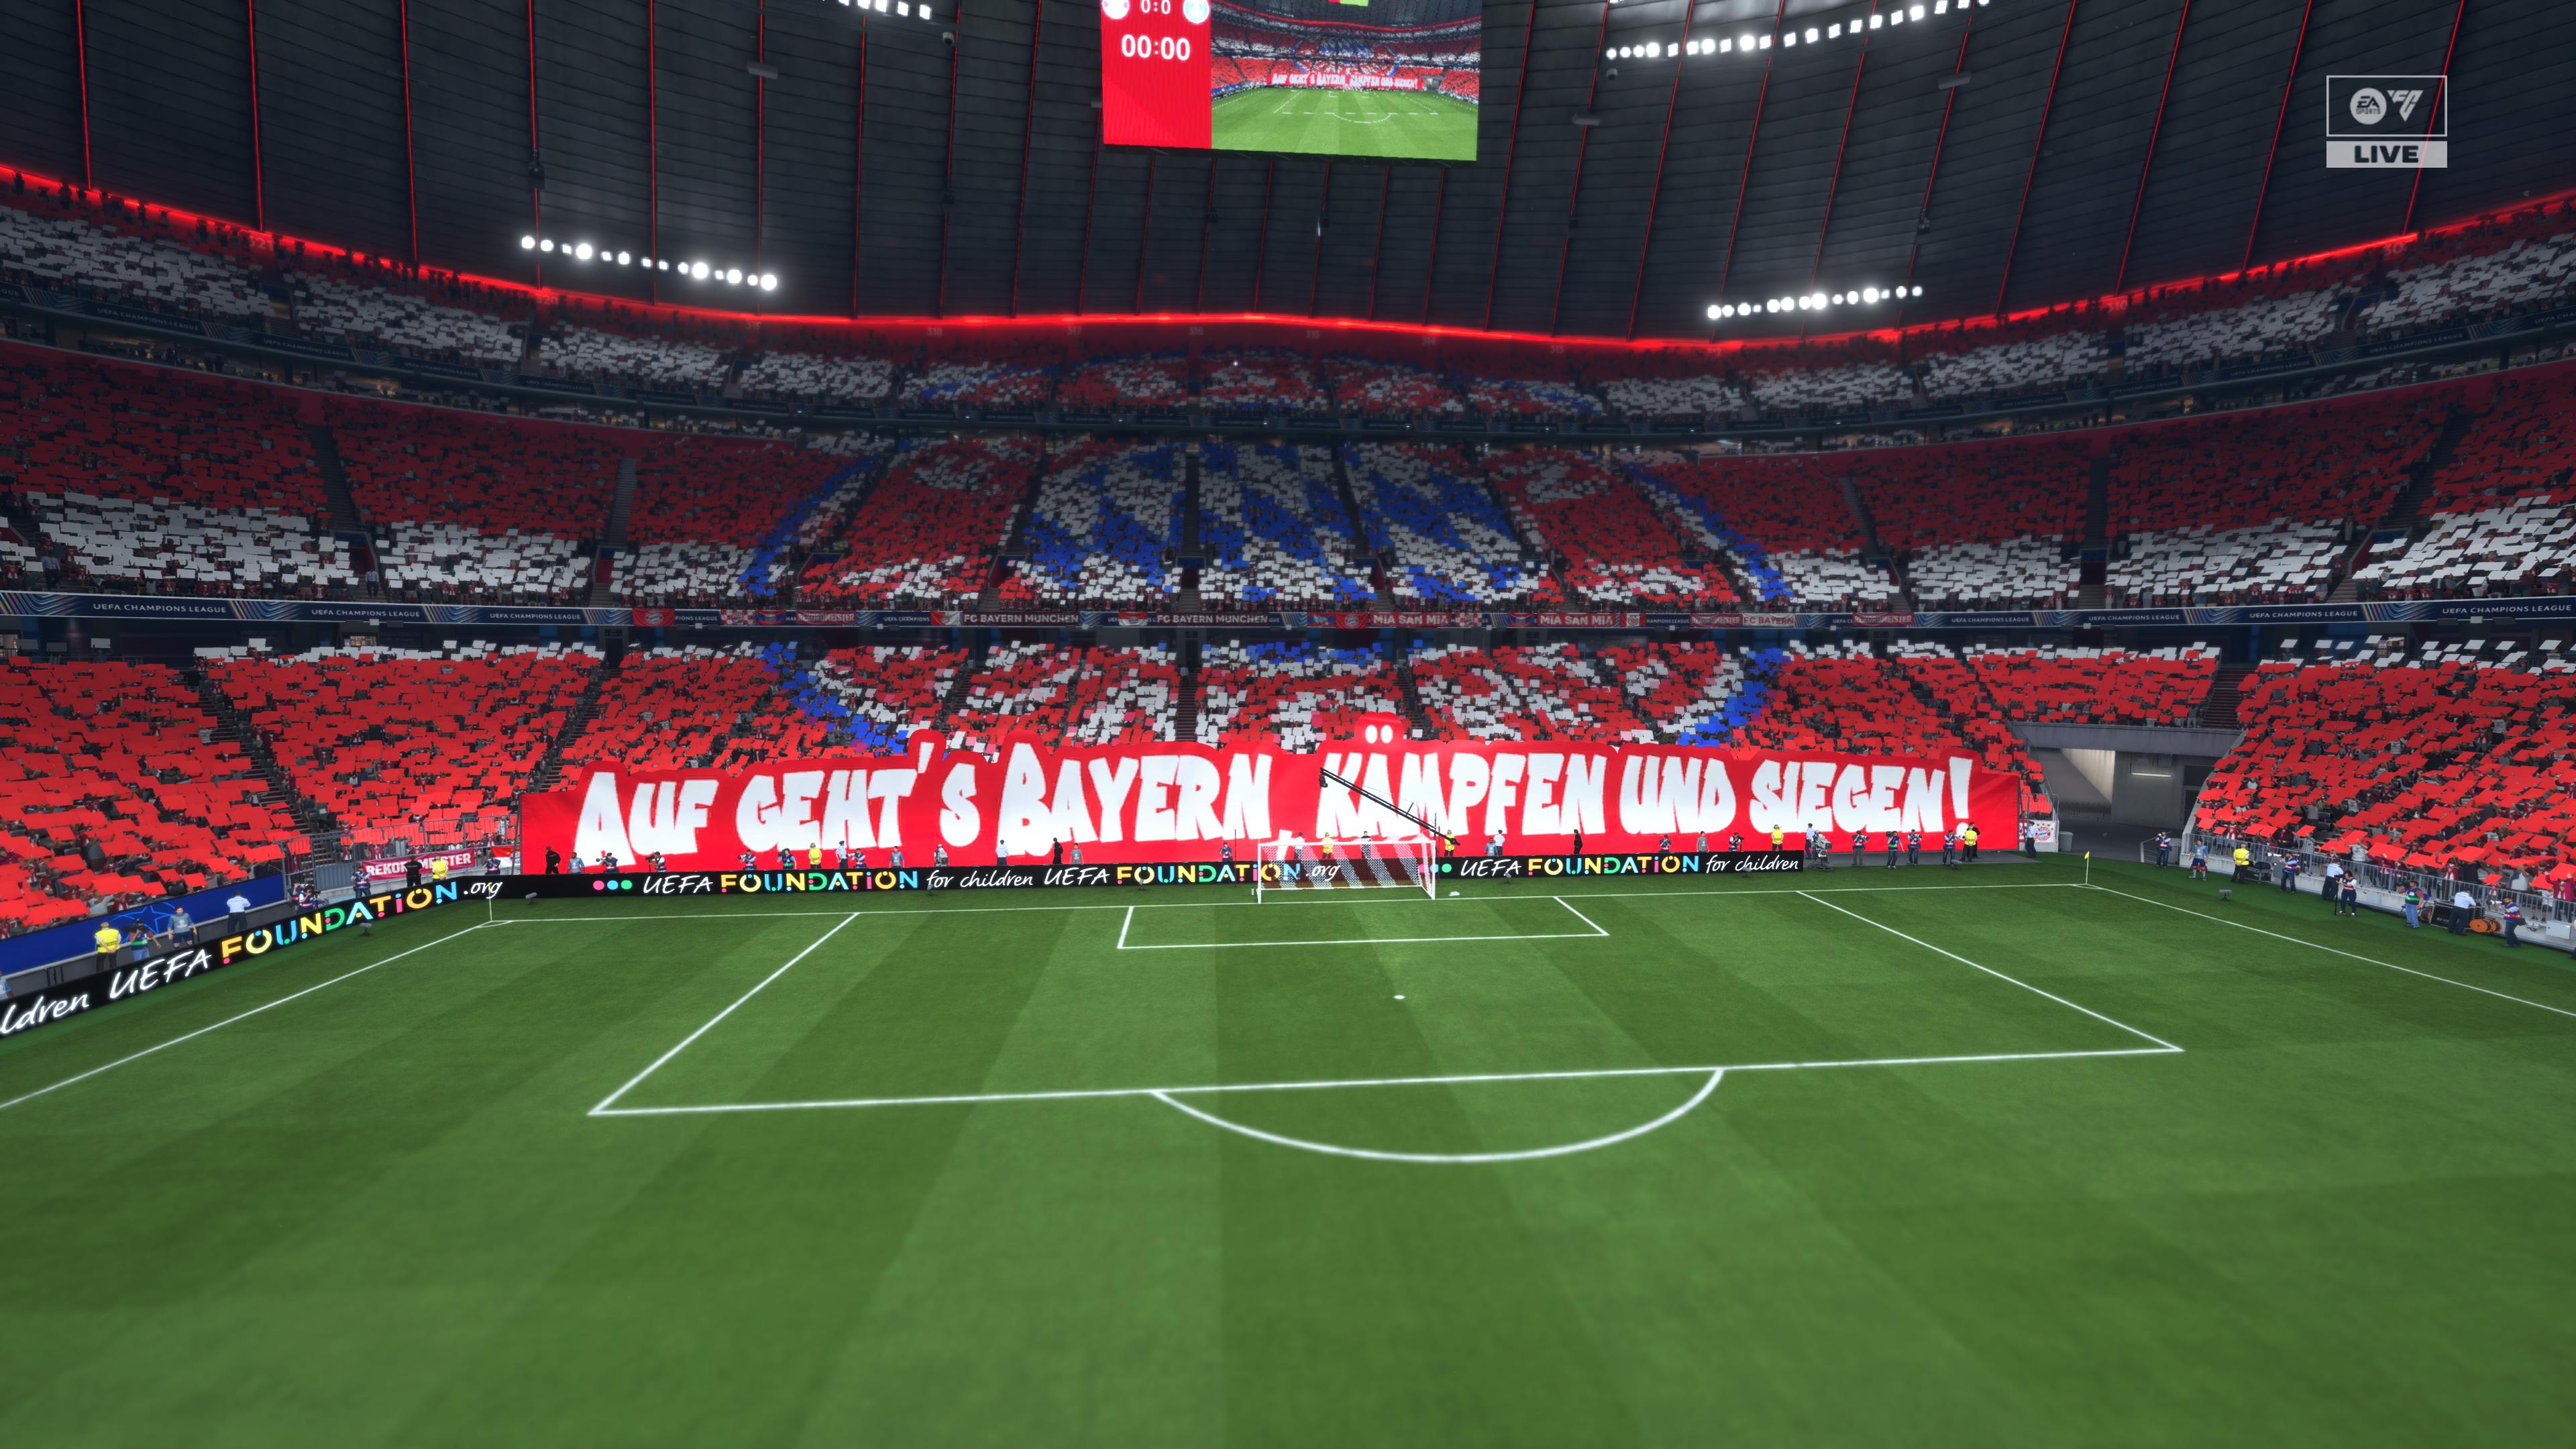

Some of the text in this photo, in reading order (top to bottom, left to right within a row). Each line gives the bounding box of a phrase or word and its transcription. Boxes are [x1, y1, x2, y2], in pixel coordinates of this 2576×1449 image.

[1122, 34, 1191, 61] 00:00
[97, 307, 199, 331] UEFA CHAMPIONS LEAGUE
[2389, 339, 2432, 350] CHAMPIONS
[2434, 333, 2464, 343] LEAGUE
[964, 614, 977, 623] FC
[980, 614, 1022, 623] BAYERN
[1157, 614, 1170, 623] FC
[1173, 614, 1213, 623] BAYERN
[1399, 614, 1423, 624] SAN
[1564, 615, 1589, 625] SAN
[574, 771, 720, 868] AUF
[1316, 723, 1608, 839] KÄMPFEN
[1619, 755, 1737, 835] UND
[1748, 756, 1974, 837] SIEGEN!
[1460, 854, 1799, 877] UEFA FOUNDATION for children
[642, 875, 714, 894] UEFA
[720, 870, 918, 893] FOUNDATION
[926, 870, 955, 888] for
[959, 869, 1034, 888] children
[1043, 867, 1110, 885] UEFA
[108, 947, 213, 1002] UEFA
[220, 880, 458, 965] FOUNDATION
[464, 881, 503, 900] .org
